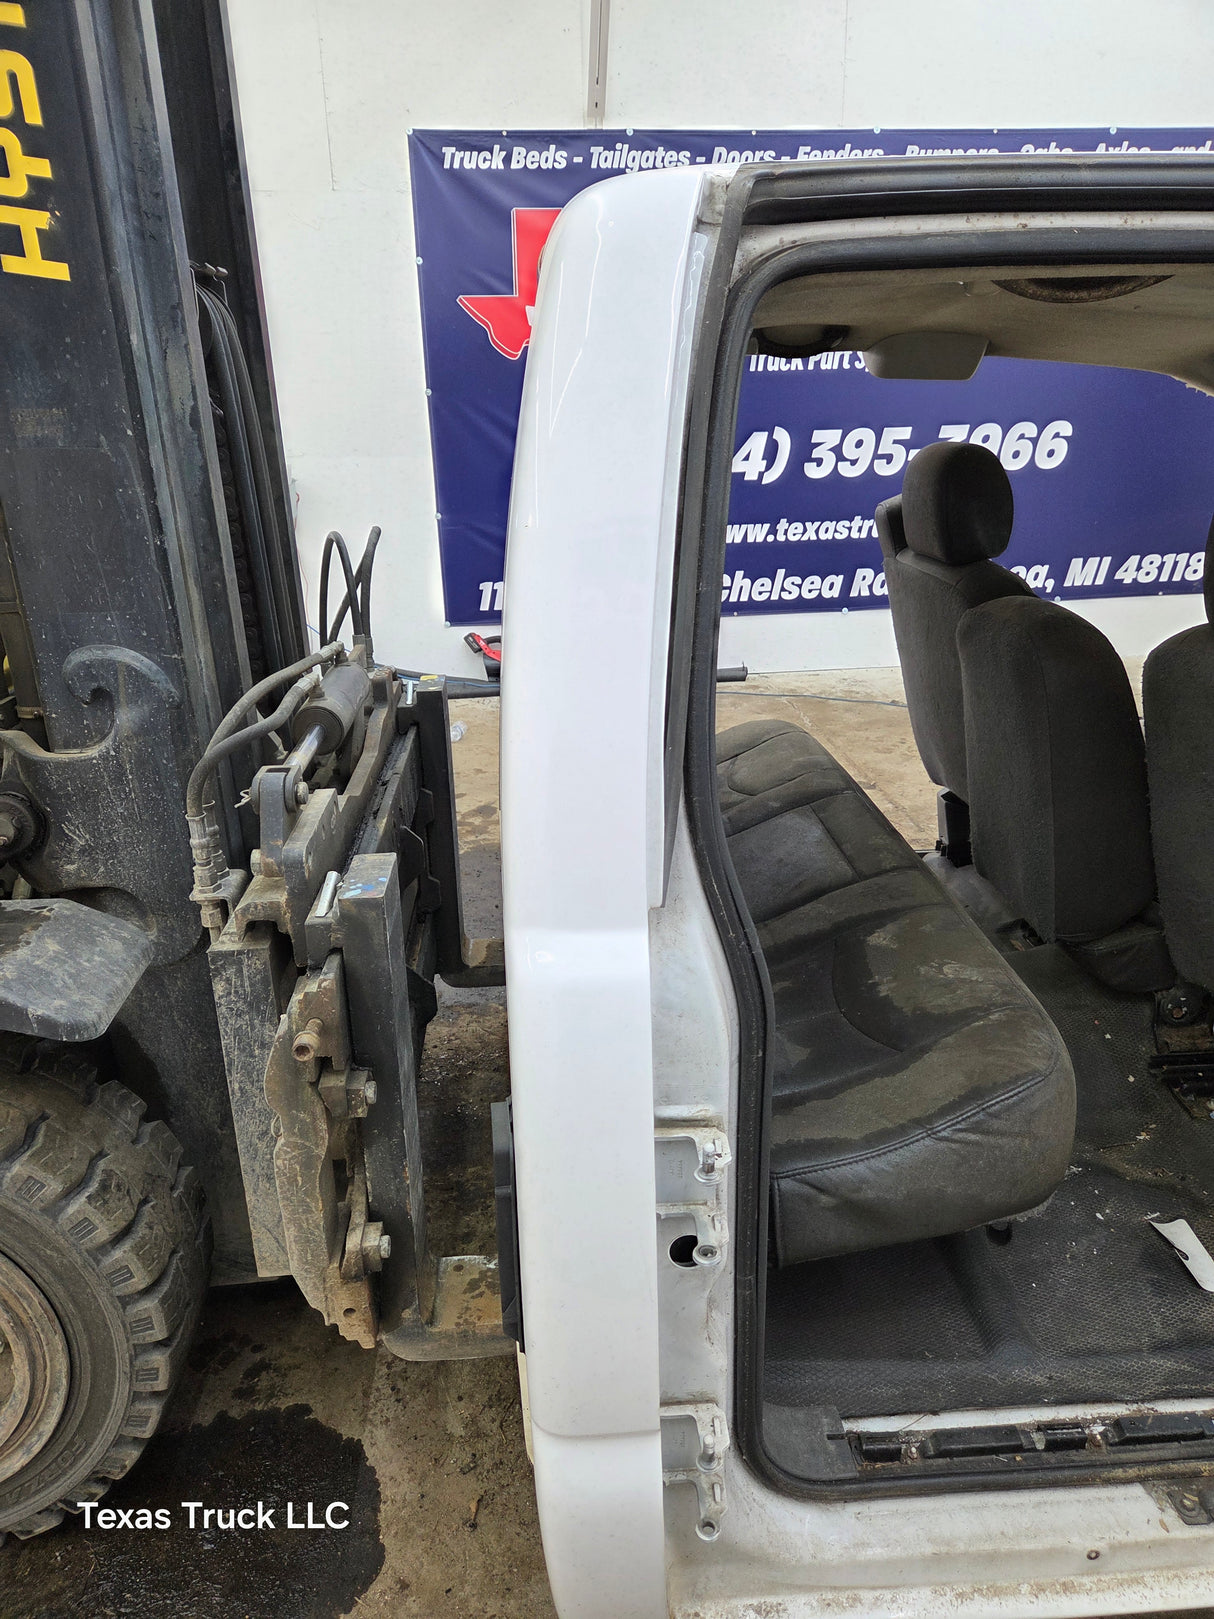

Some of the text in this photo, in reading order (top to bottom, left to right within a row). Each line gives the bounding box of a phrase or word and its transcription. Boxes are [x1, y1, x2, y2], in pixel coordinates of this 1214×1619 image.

[442, 145, 505, 170] Truck
[510, 145, 567, 170] Beds
[590, 143, 691, 173] Tailgates
[807, 351, 853, 371] Part
[1063, 556, 1112, 587] MI
[1114, 551, 1206, 584] 48118
